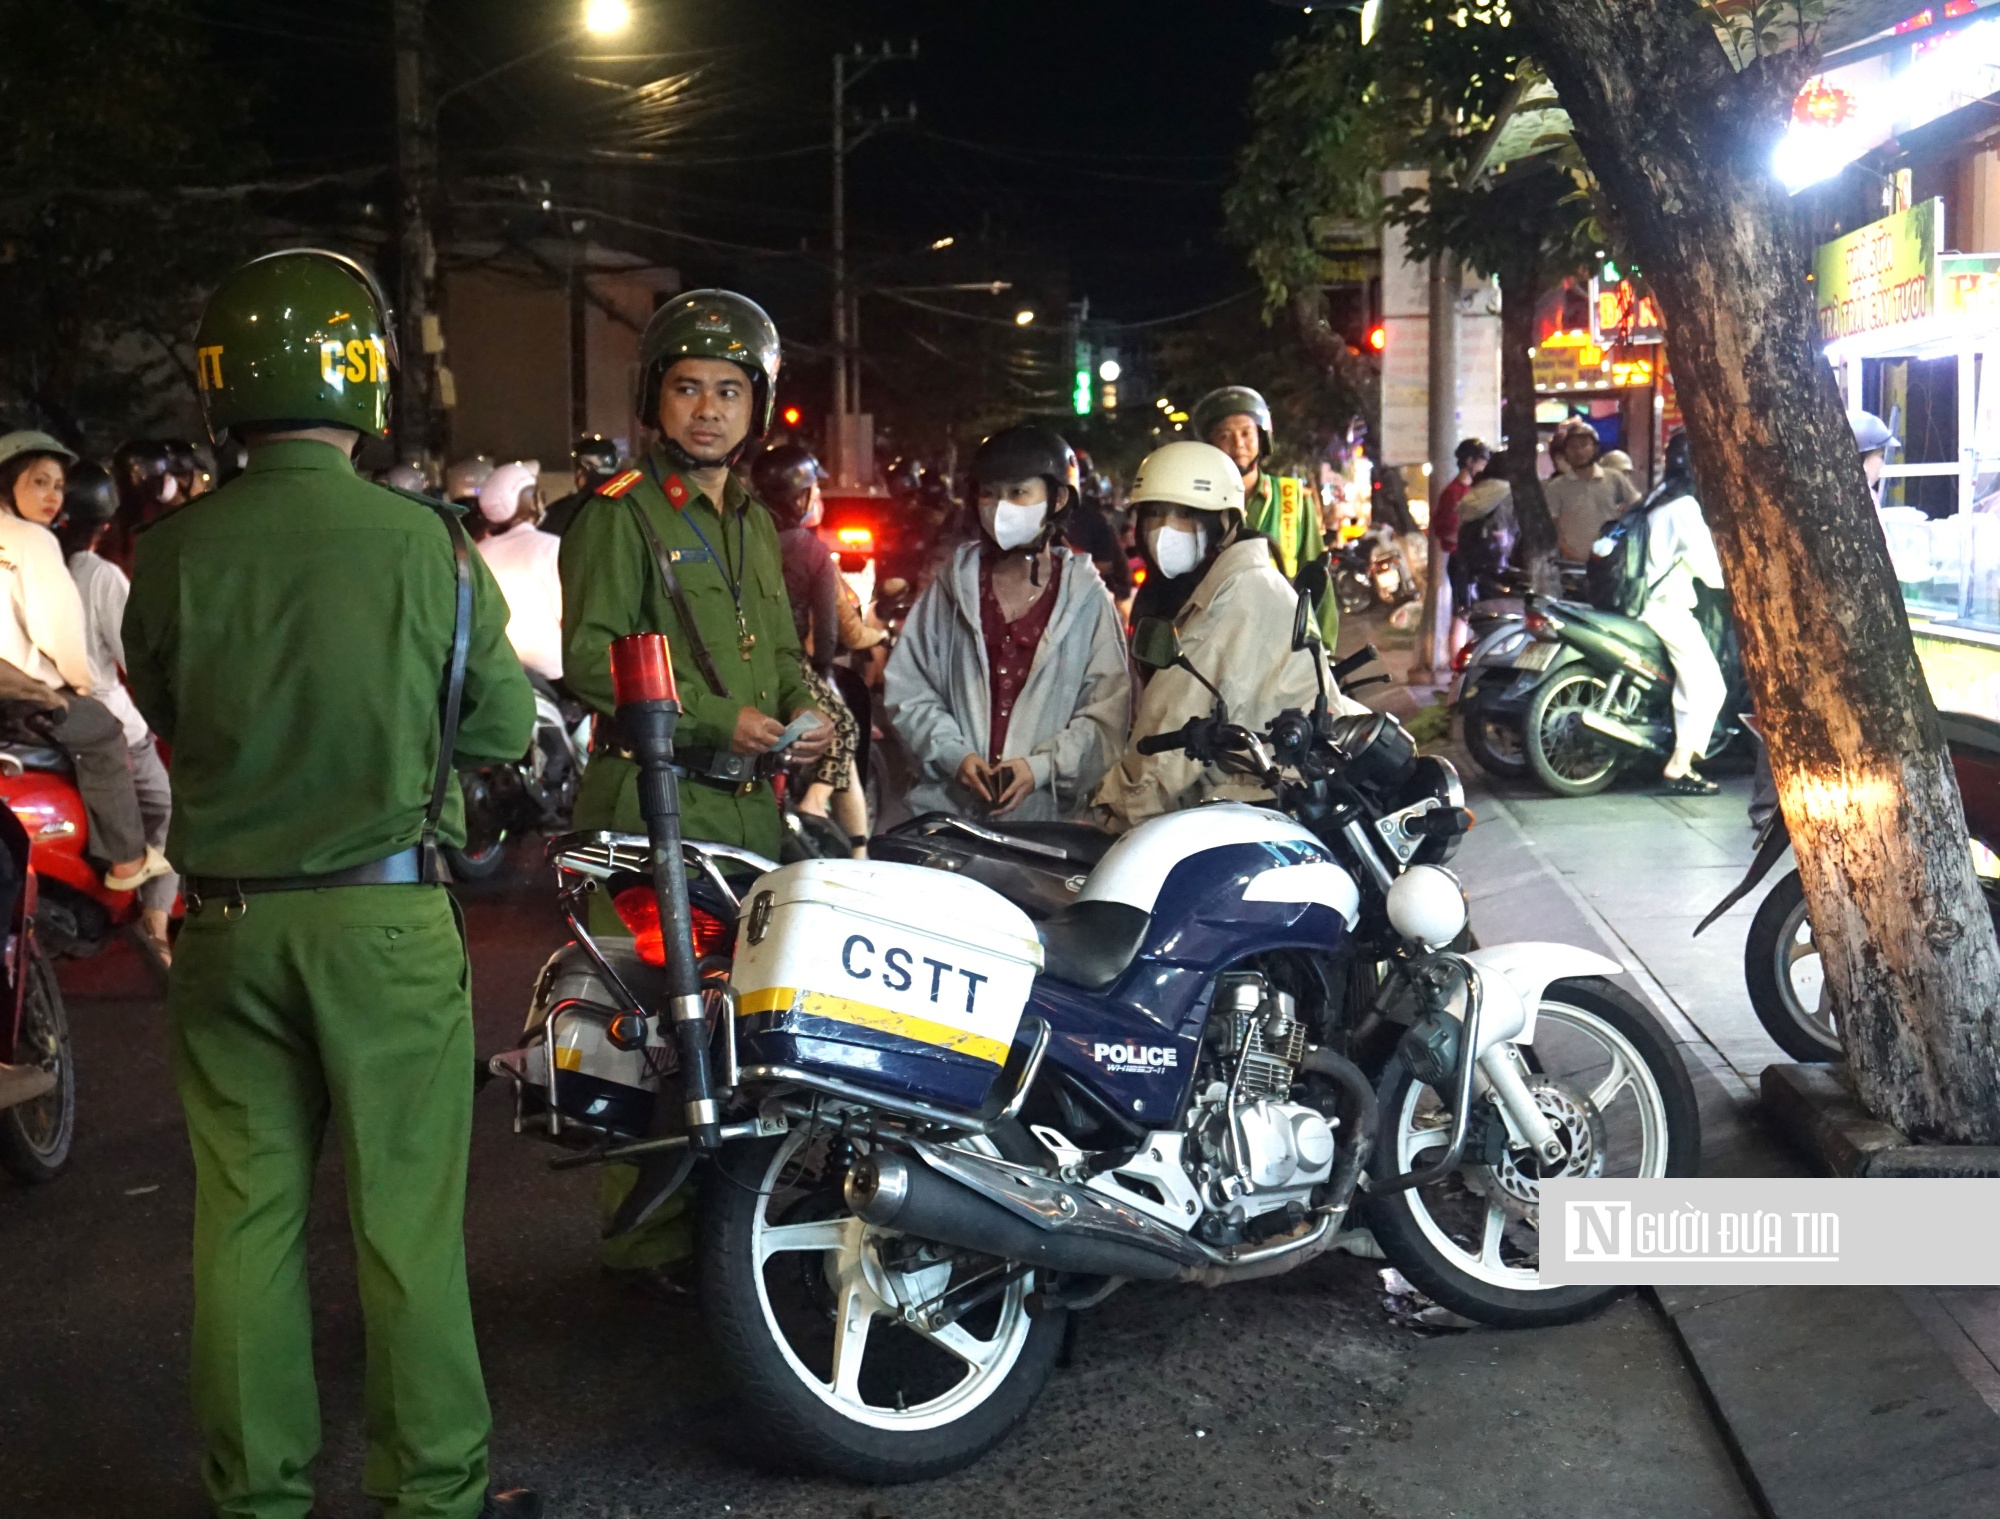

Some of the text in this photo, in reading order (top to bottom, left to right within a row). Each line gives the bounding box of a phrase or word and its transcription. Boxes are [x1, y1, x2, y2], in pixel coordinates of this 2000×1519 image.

[1282, 484, 1294, 550] CSTT
[841, 934, 989, 1014] CSTT
[1094, 1043, 1178, 1067] POLICE
